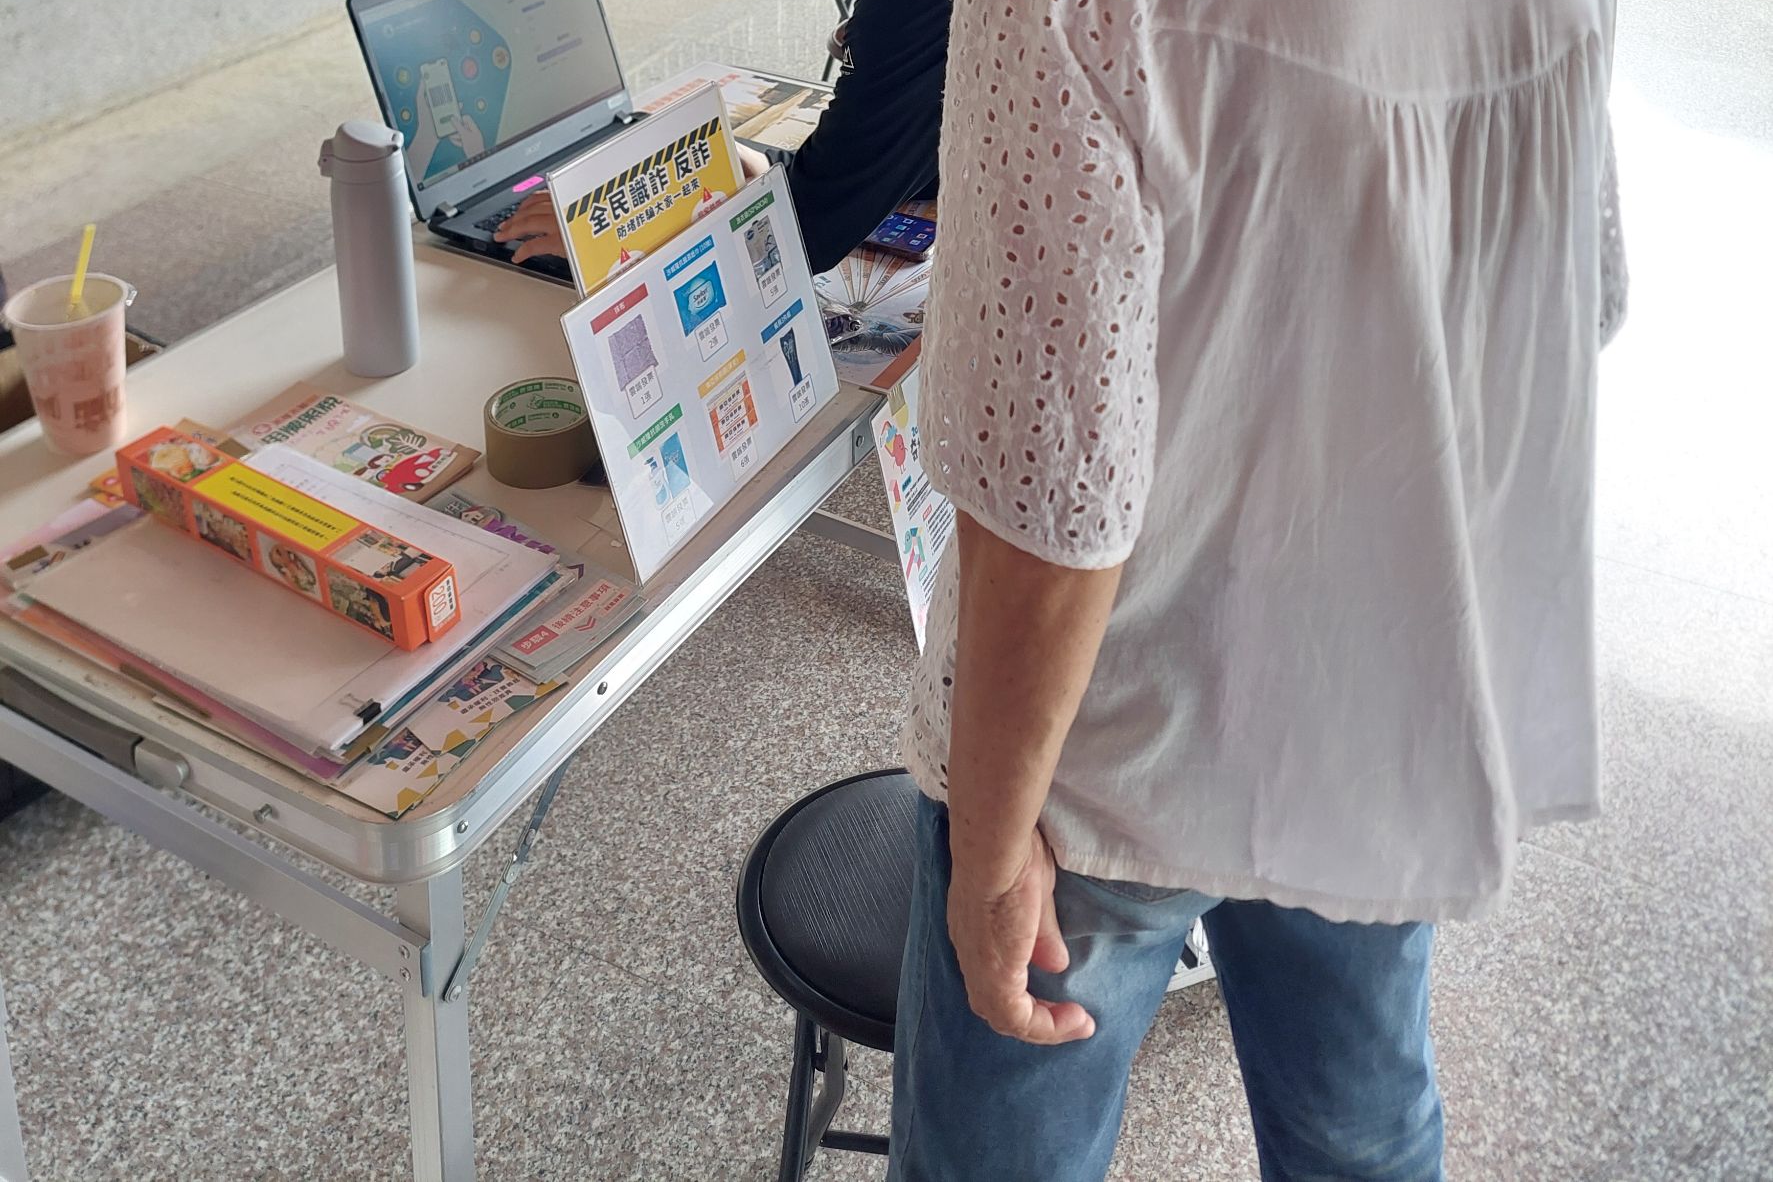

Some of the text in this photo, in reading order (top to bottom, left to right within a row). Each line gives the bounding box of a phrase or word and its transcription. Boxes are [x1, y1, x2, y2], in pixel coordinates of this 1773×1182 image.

[589, 141, 711, 235] 全民識詐 反詐
[616, 178, 701, 239] 防堵詐騙大家一起來
[698, 318, 721, 341] 雲端發票
[628, 372, 655, 397] 雲端發票
[640, 391, 652, 405] 1張
[432, 585, 447, 615] 200
[551, 583, 612, 630] 後續注意事項
